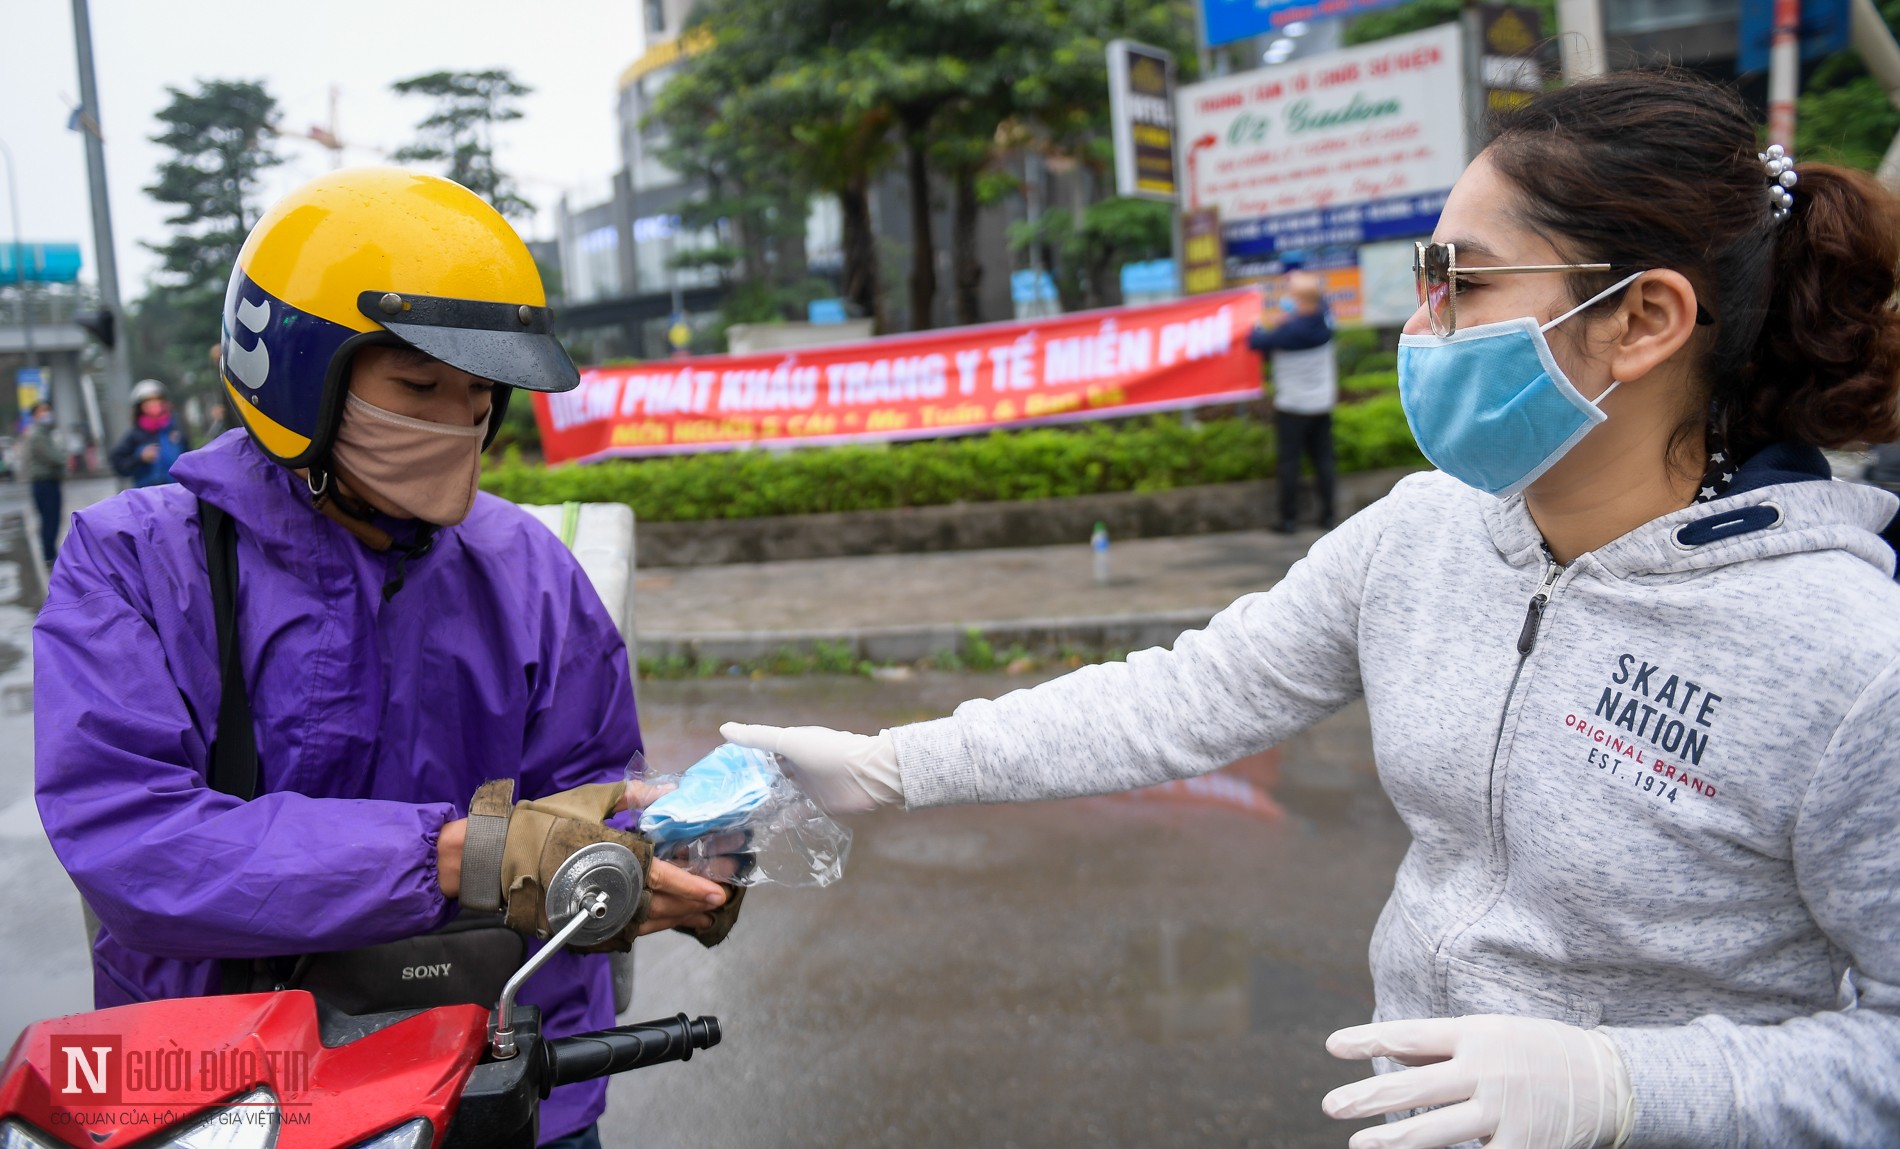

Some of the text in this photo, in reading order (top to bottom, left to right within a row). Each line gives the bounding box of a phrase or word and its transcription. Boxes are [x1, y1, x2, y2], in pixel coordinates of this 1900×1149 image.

[620, 366, 716, 417] PHÁT
[718, 354, 819, 412] KHẨU
[826, 352, 948, 407] TRANG
[955, 348, 981, 396] Y
[988, 330, 1038, 392] TẾ
[1043, 317, 1150, 386] MIỄN
[1158, 303, 1232, 367] PHÍ
[1595, 687, 1708, 766] NATION
[1612, 654, 1722, 727] SKATE
[1565, 714, 1716, 798] ORIGINAL BRAND
[1588, 748, 1678, 803] EST. 1974
[402, 963, 451, 979] SONY
